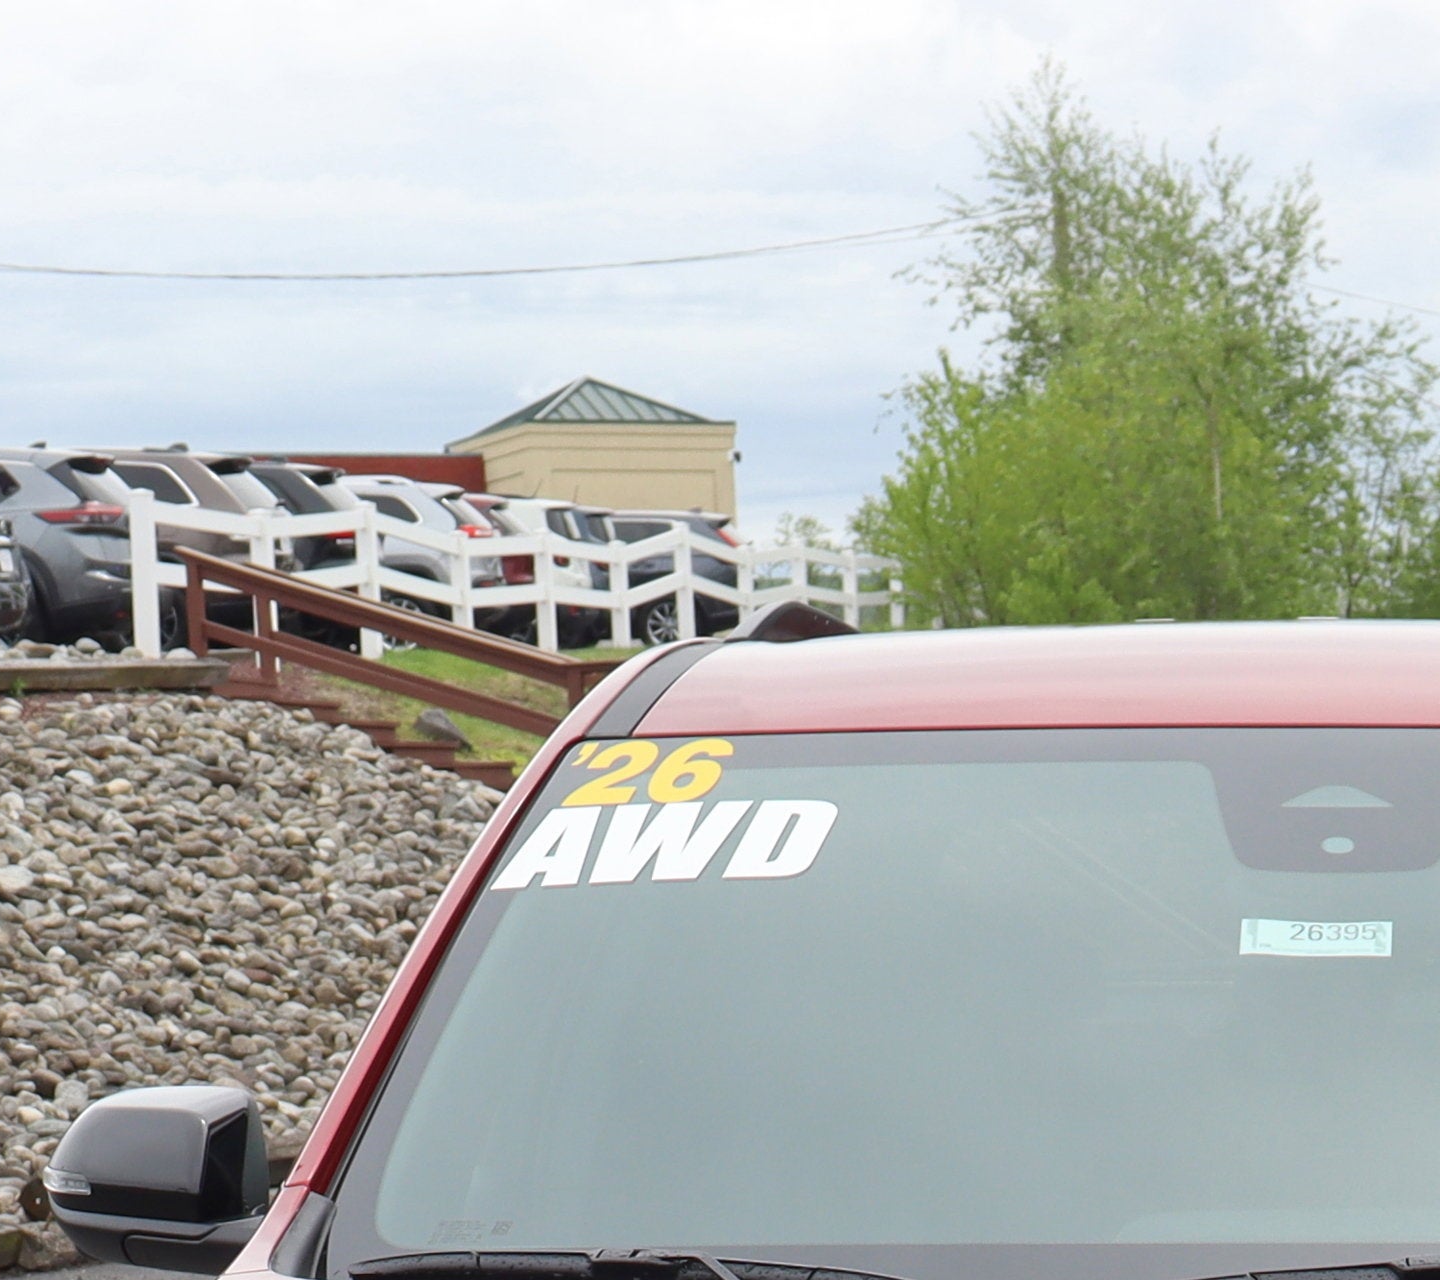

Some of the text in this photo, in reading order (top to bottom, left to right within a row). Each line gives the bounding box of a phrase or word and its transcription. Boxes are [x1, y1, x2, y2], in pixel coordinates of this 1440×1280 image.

[561, 738, 735, 807] '26
[490, 799, 839, 890] AWD
[1288, 923, 1377, 941] 26395
